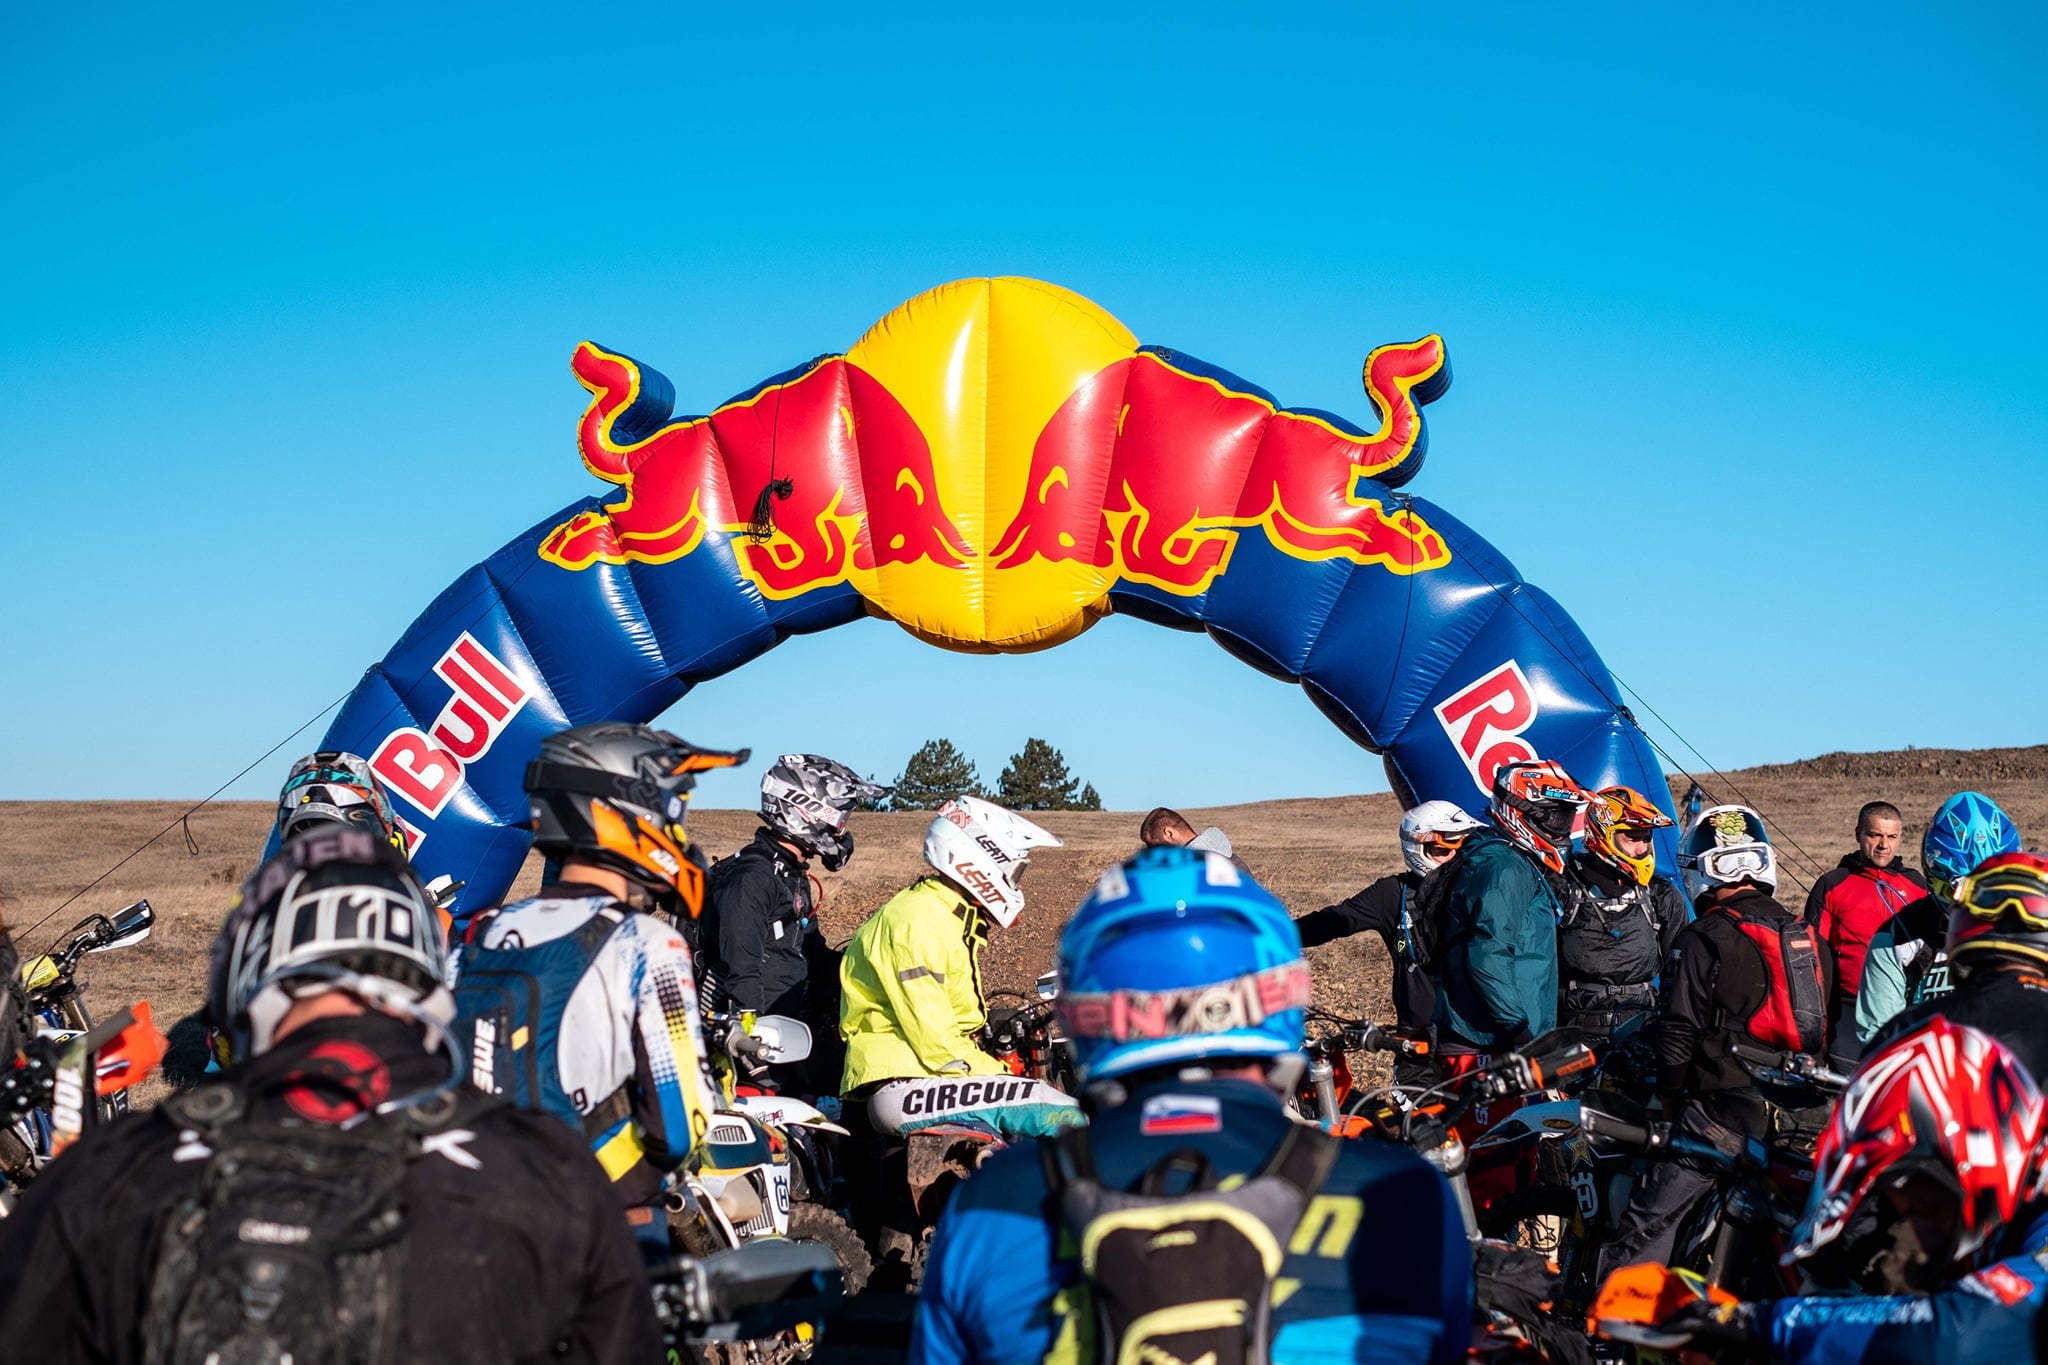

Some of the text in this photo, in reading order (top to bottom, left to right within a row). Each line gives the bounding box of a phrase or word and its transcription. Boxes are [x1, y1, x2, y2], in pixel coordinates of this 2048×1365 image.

[370, 635, 528, 814] Bull
[1438, 663, 1552, 808] Re
[1546, 785, 1580, 797] GoPro
[975, 834, 1012, 865] LEATT
[955, 861, 1007, 905] LEATT
[901, 1080, 1040, 1116] CIRCUIT
